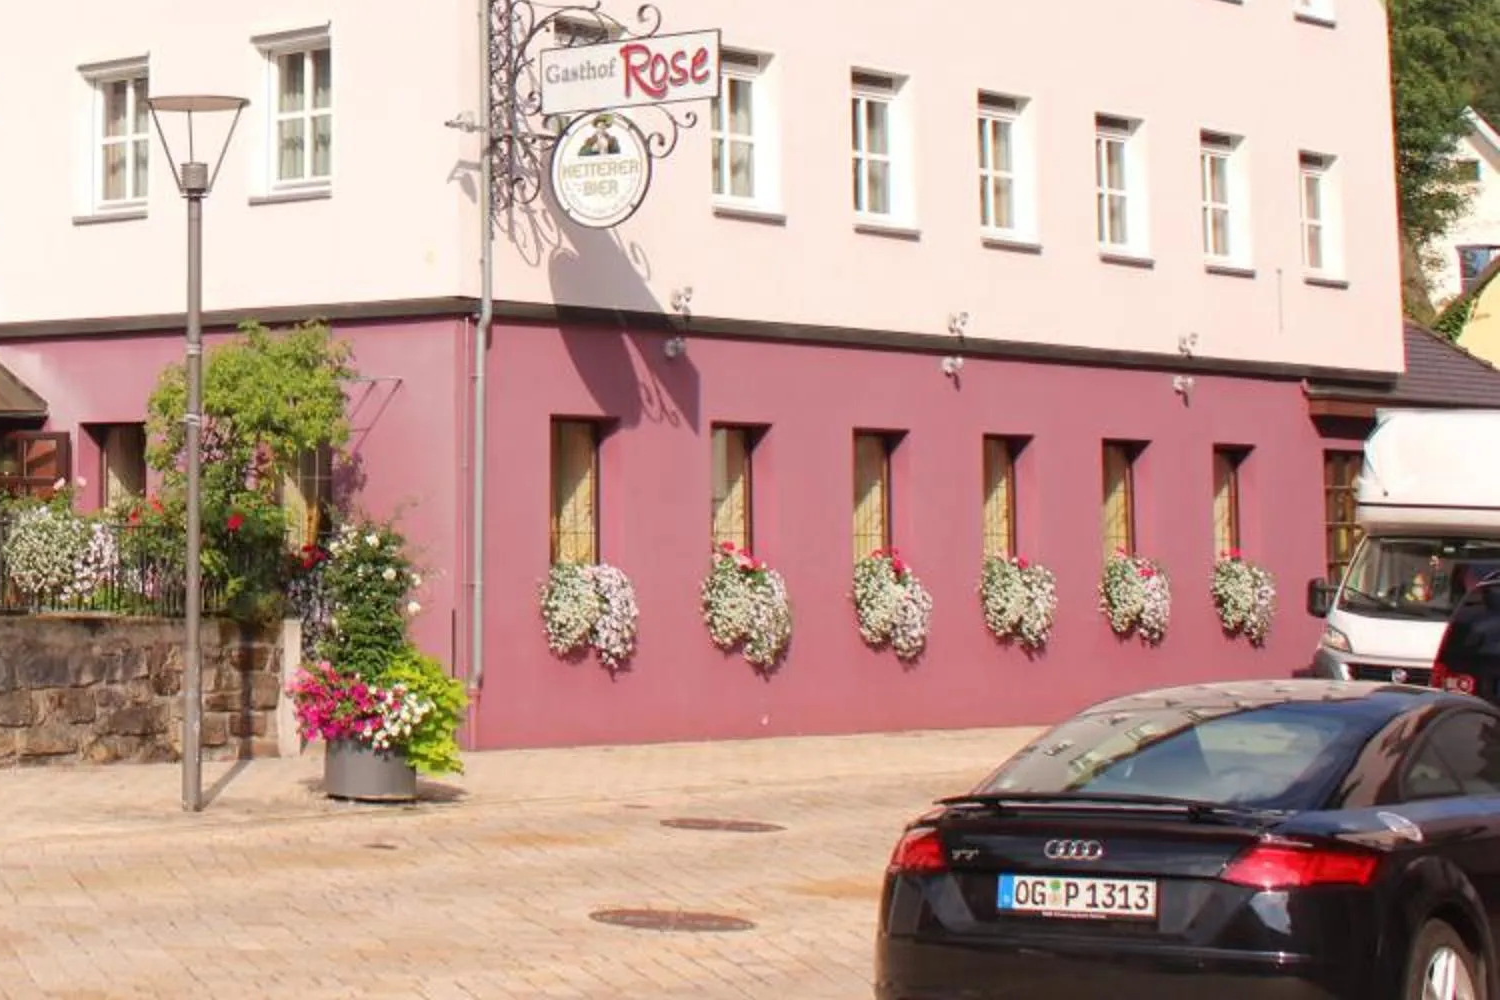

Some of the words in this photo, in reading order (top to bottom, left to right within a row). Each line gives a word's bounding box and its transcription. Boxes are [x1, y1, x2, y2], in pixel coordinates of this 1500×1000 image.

[545, 57, 617, 85] Gasthof
[619, 43, 710, 100] Rose
[583, 179, 619, 196] BIER
[1014, 880, 1046, 905] OG
[1064, 882, 1079, 907] P
[1085, 883, 1149, 910] 1313
